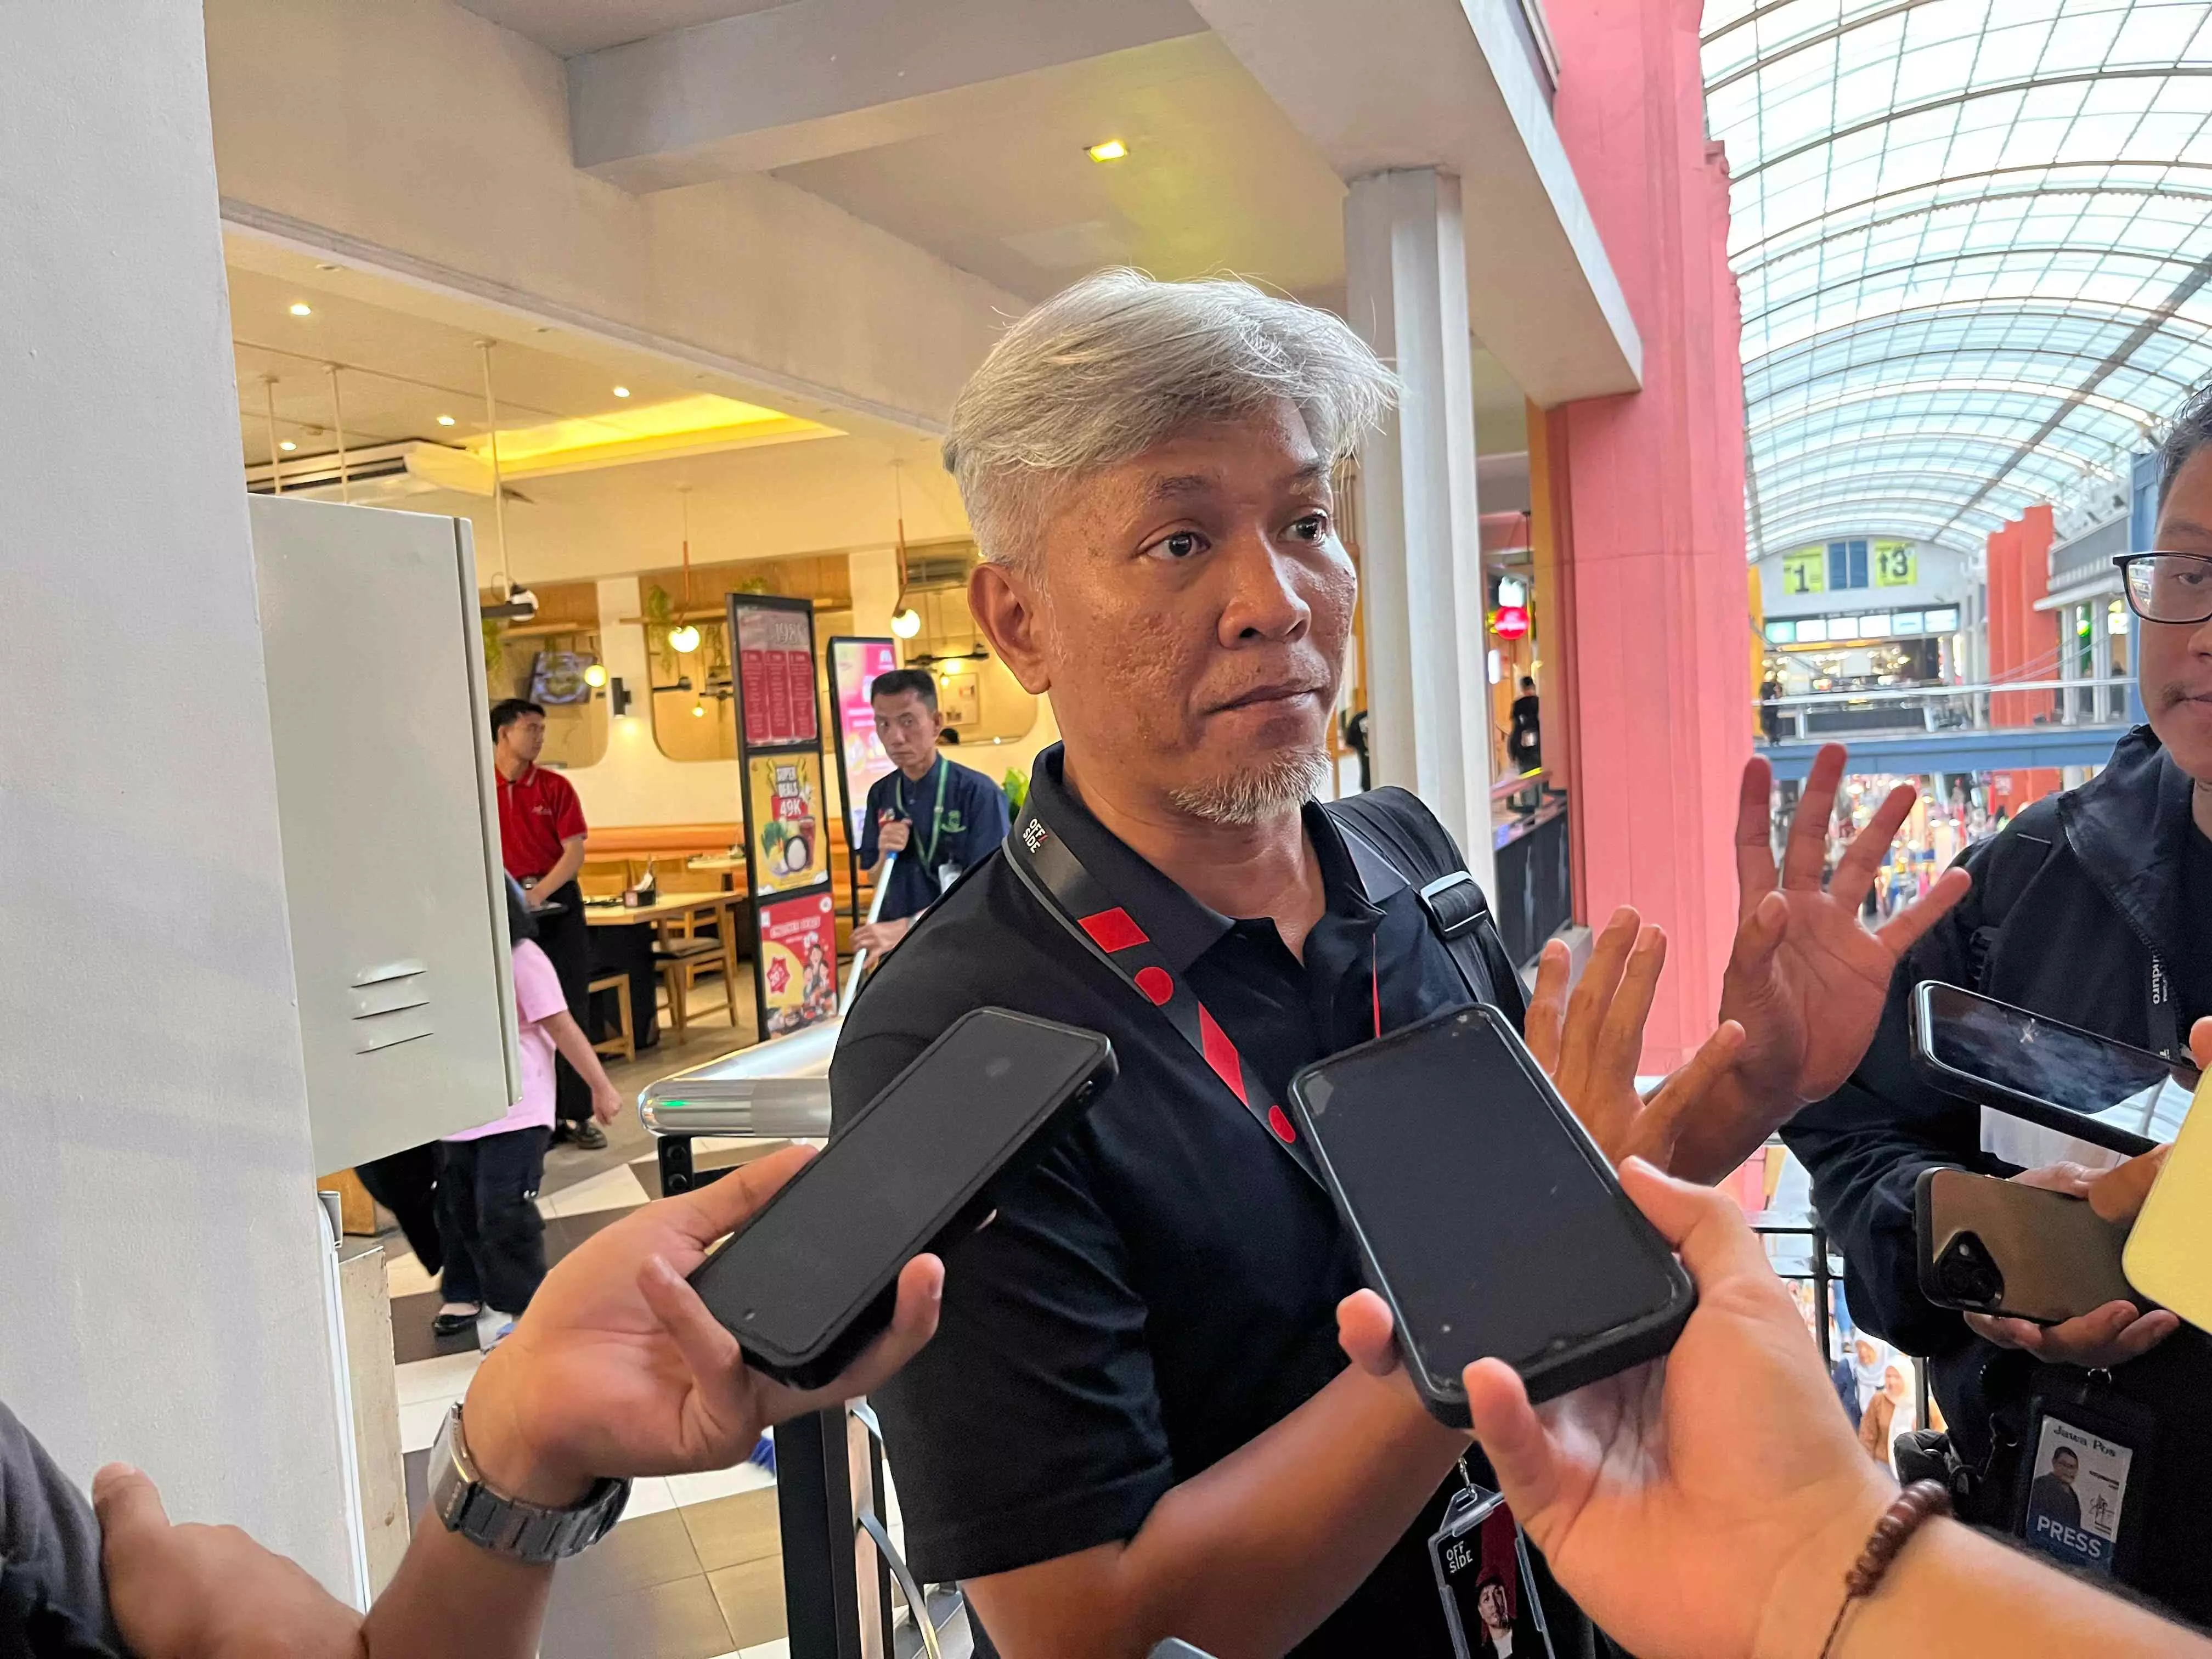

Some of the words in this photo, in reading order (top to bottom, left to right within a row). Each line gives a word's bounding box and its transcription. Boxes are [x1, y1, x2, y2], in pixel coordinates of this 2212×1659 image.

[780, 798, 802, 817] 49K
[1029, 818, 1046, 838] OFF
[1023, 827, 1041, 854] SIDE
[2053, 1425, 2087, 1446] Jawa
[2093, 1440, 2116, 1457] Pos
[2036, 1515, 2102, 1558] PRESS
[1446, 1540, 1464, 1561] OFF
[1449, 1550, 1473, 1573] SIDE
